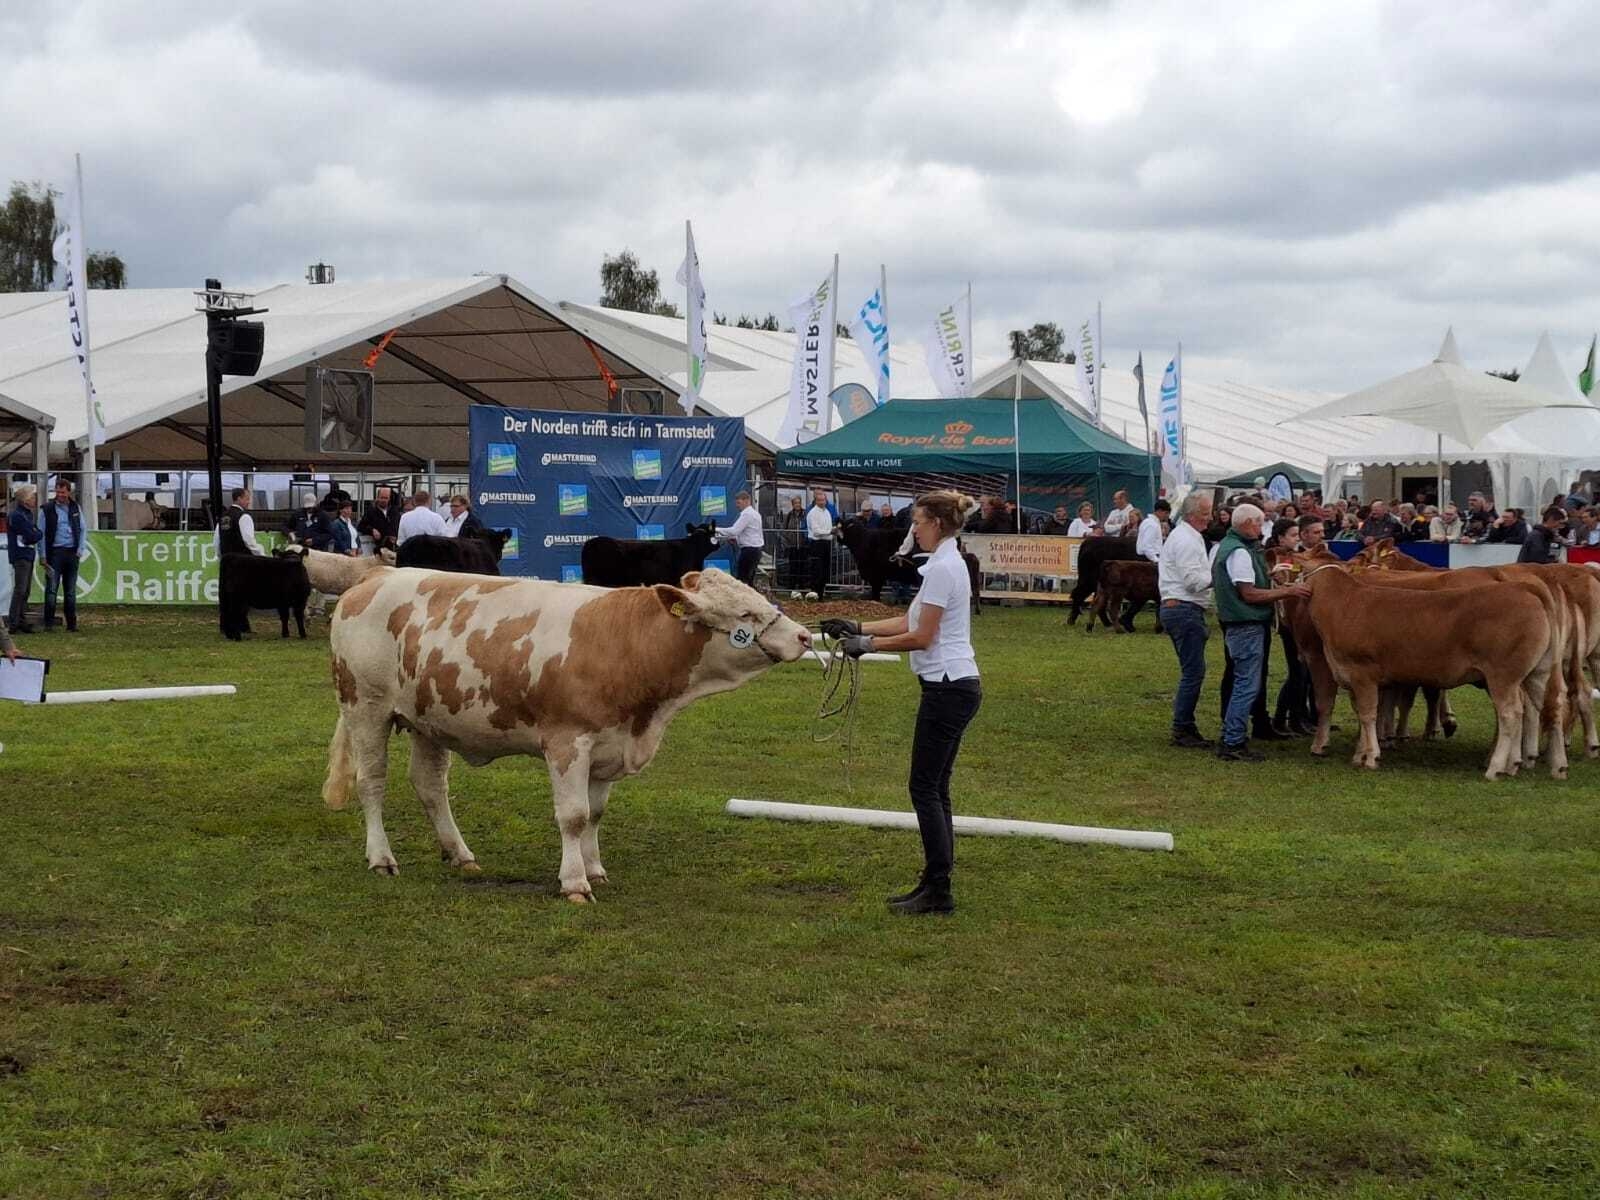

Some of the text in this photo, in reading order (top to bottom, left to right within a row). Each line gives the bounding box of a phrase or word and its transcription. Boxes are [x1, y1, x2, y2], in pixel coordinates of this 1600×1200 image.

[504, 416, 715, 439] Der Norden trifft sich in Tarmstedt
[878, 432, 935, 446] Royal
[939, 434, 966, 446] de
[816, 459, 840, 467] COWS
[843, 459, 861, 467] FEEL
[864, 459, 874, 467] AT
[877, 459, 902, 467] HOME
[116, 569, 220, 601] Raiffe
[733, 628, 751, 644] 92
